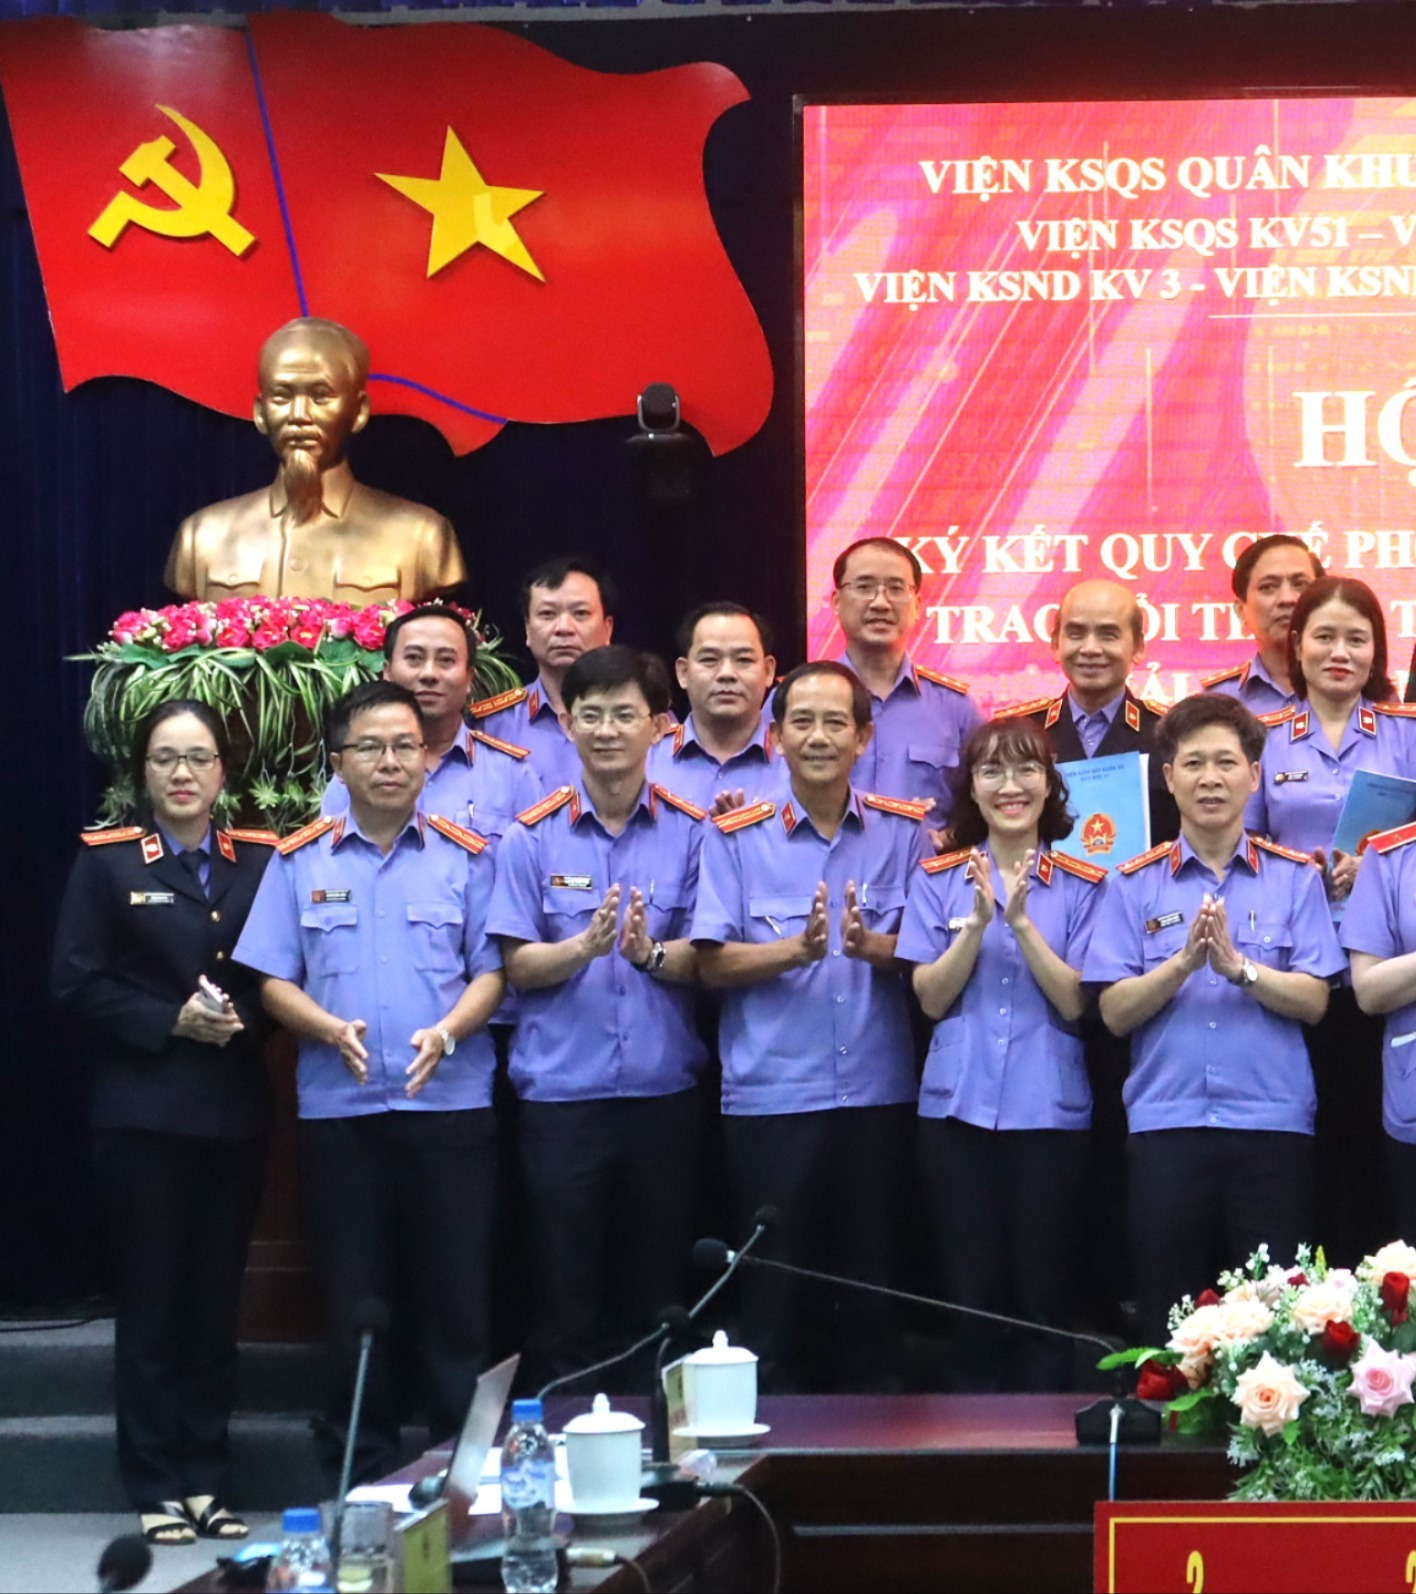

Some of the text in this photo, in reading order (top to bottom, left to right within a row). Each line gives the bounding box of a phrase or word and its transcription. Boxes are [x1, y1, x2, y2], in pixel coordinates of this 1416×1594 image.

[920, 155, 1031, 200] VIỆN
[1046, 157, 1166, 198] KSQS
[1179, 145, 1310, 197] QUÂN
[1018, 217, 1118, 259] VIỆN
[1131, 217, 1239, 257] KSQS
[1250, 213, 1350, 249] KV51
[854, 270, 955, 311] VIỆN
[968, 270, 1081, 302] KSND
[1091, 269, 1152, 300] KV
[1160, 269, 1182, 300] 3
[1216, 267, 1322, 308] VIỆN
[983, 523, 1089, 574] KẾT
[1100, 532, 1213, 579] QUY
